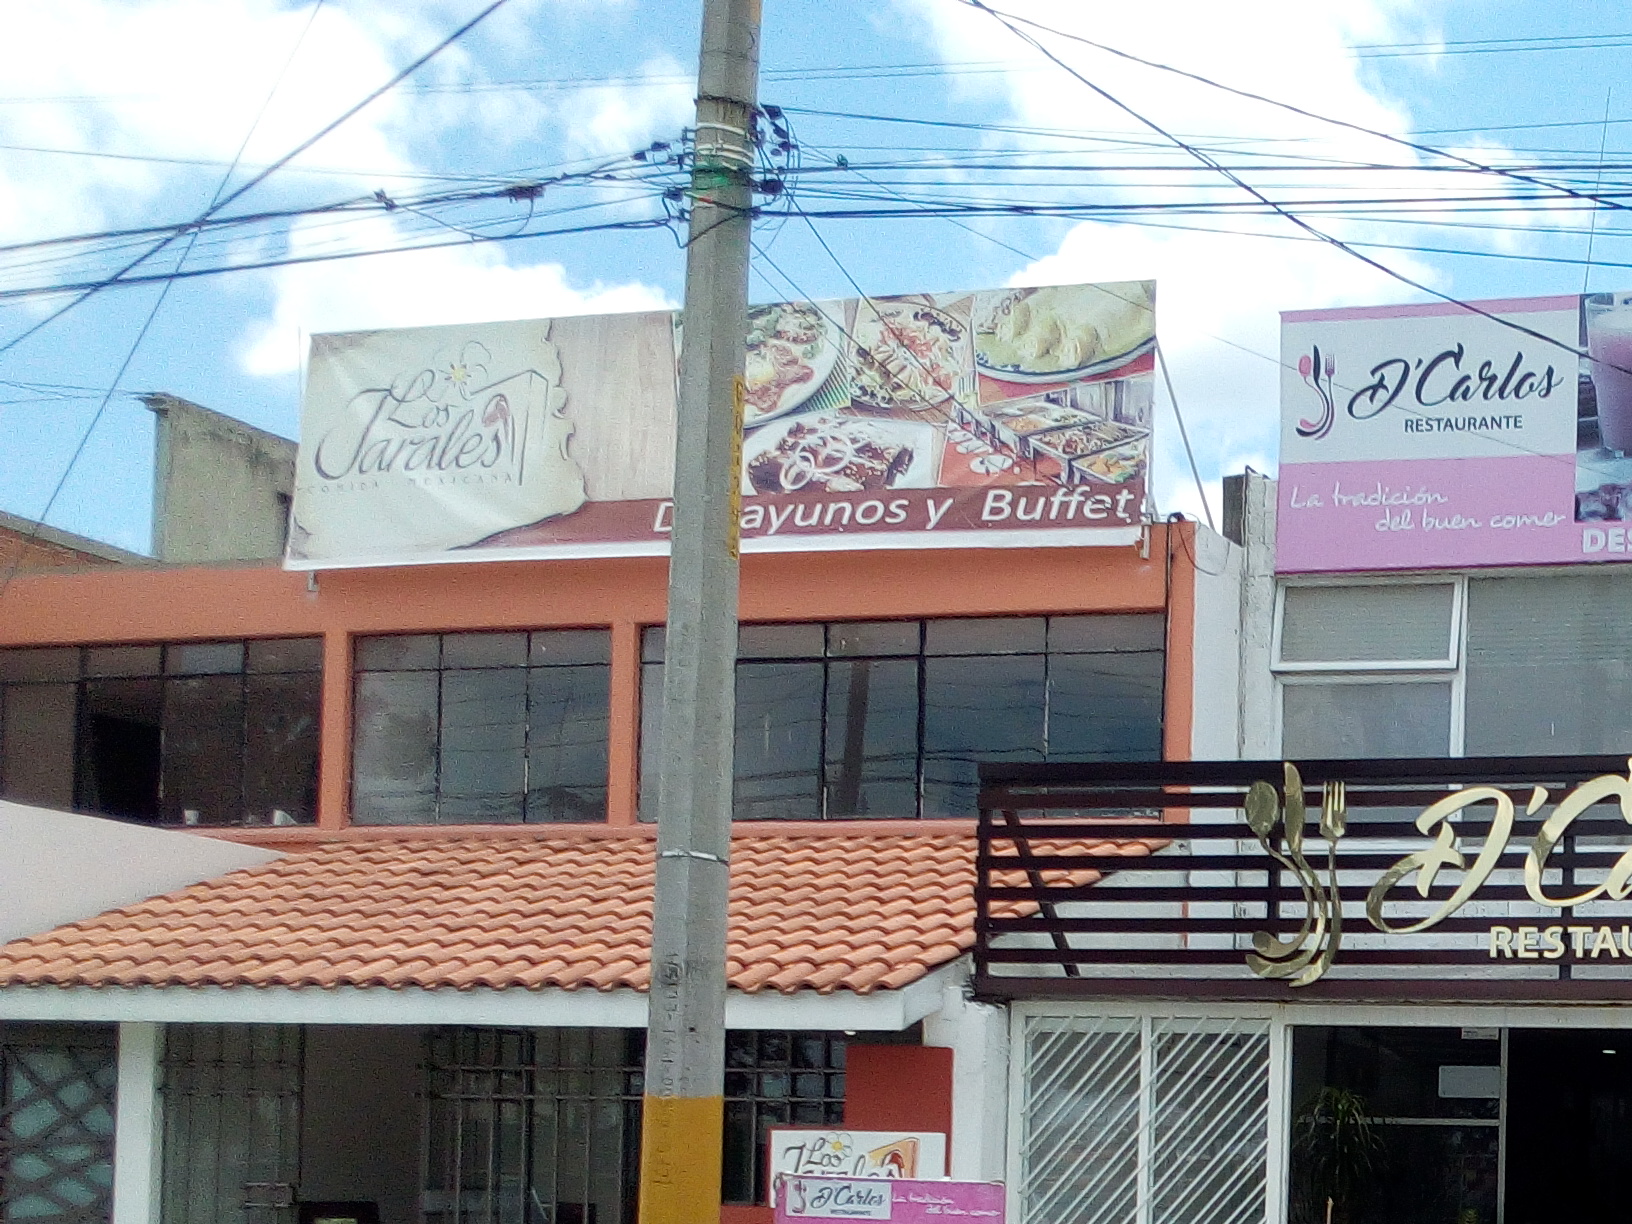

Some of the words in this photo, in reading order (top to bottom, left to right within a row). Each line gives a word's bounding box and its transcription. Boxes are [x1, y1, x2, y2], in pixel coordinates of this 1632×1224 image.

[1347, 342, 1564, 420] D'Carlos
[1403, 415, 1524, 433] RESTAURANTE
[925, 496, 955, 531] y
[981, 484, 1132, 522] Buffet
[1290, 486, 1323, 510] La
[1332, 481, 1449, 507] tradición
[1375, 509, 1416, 533] del
[1423, 508, 1480, 531] buen
[1489, 513, 1566, 530] comer
